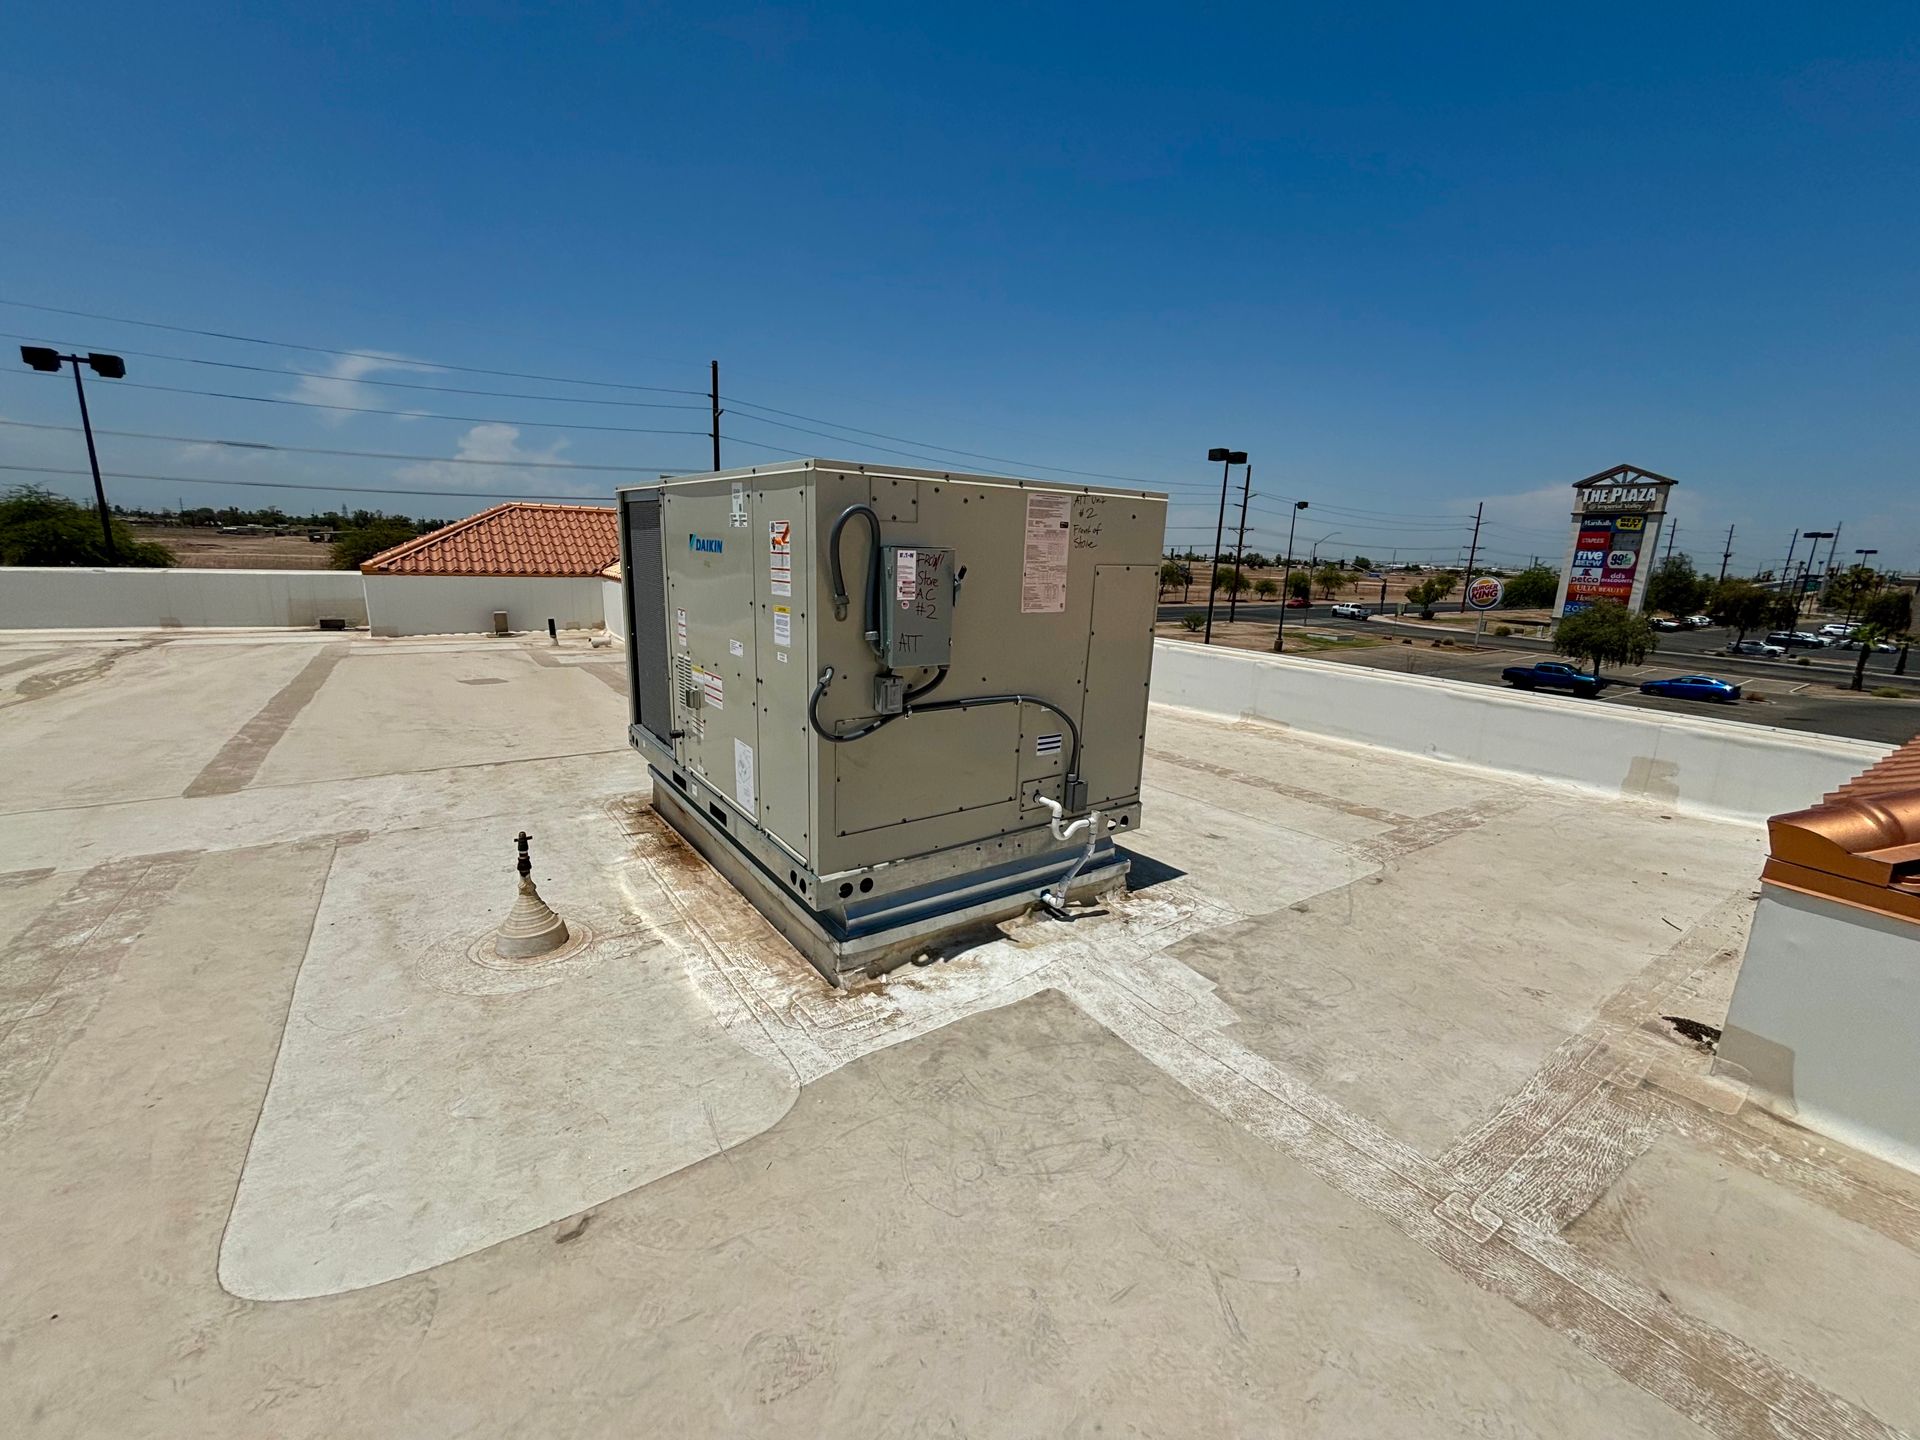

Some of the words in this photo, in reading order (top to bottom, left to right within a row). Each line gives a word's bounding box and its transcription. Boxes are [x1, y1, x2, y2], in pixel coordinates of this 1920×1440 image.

[1582, 488, 1609, 503] THE
[1609, 487, 1657, 503] PLAZA
[1582, 519, 1612, 528] Marshalls
[695, 538, 723, 554] DAIKIN
[1577, 551, 1603, 560] five
[1574, 559, 1602, 567] BELOW
[918, 570, 939, 587] Store
[1570, 576, 1599, 584] petco
[916, 588, 937, 600] AC
[1472, 584, 1499, 593] BURGER
[1574, 584, 1597, 593] ULTA
[1471, 589, 1498, 600] KING
[916, 602, 938, 620] #2
[899, 633, 924, 653] ATT
